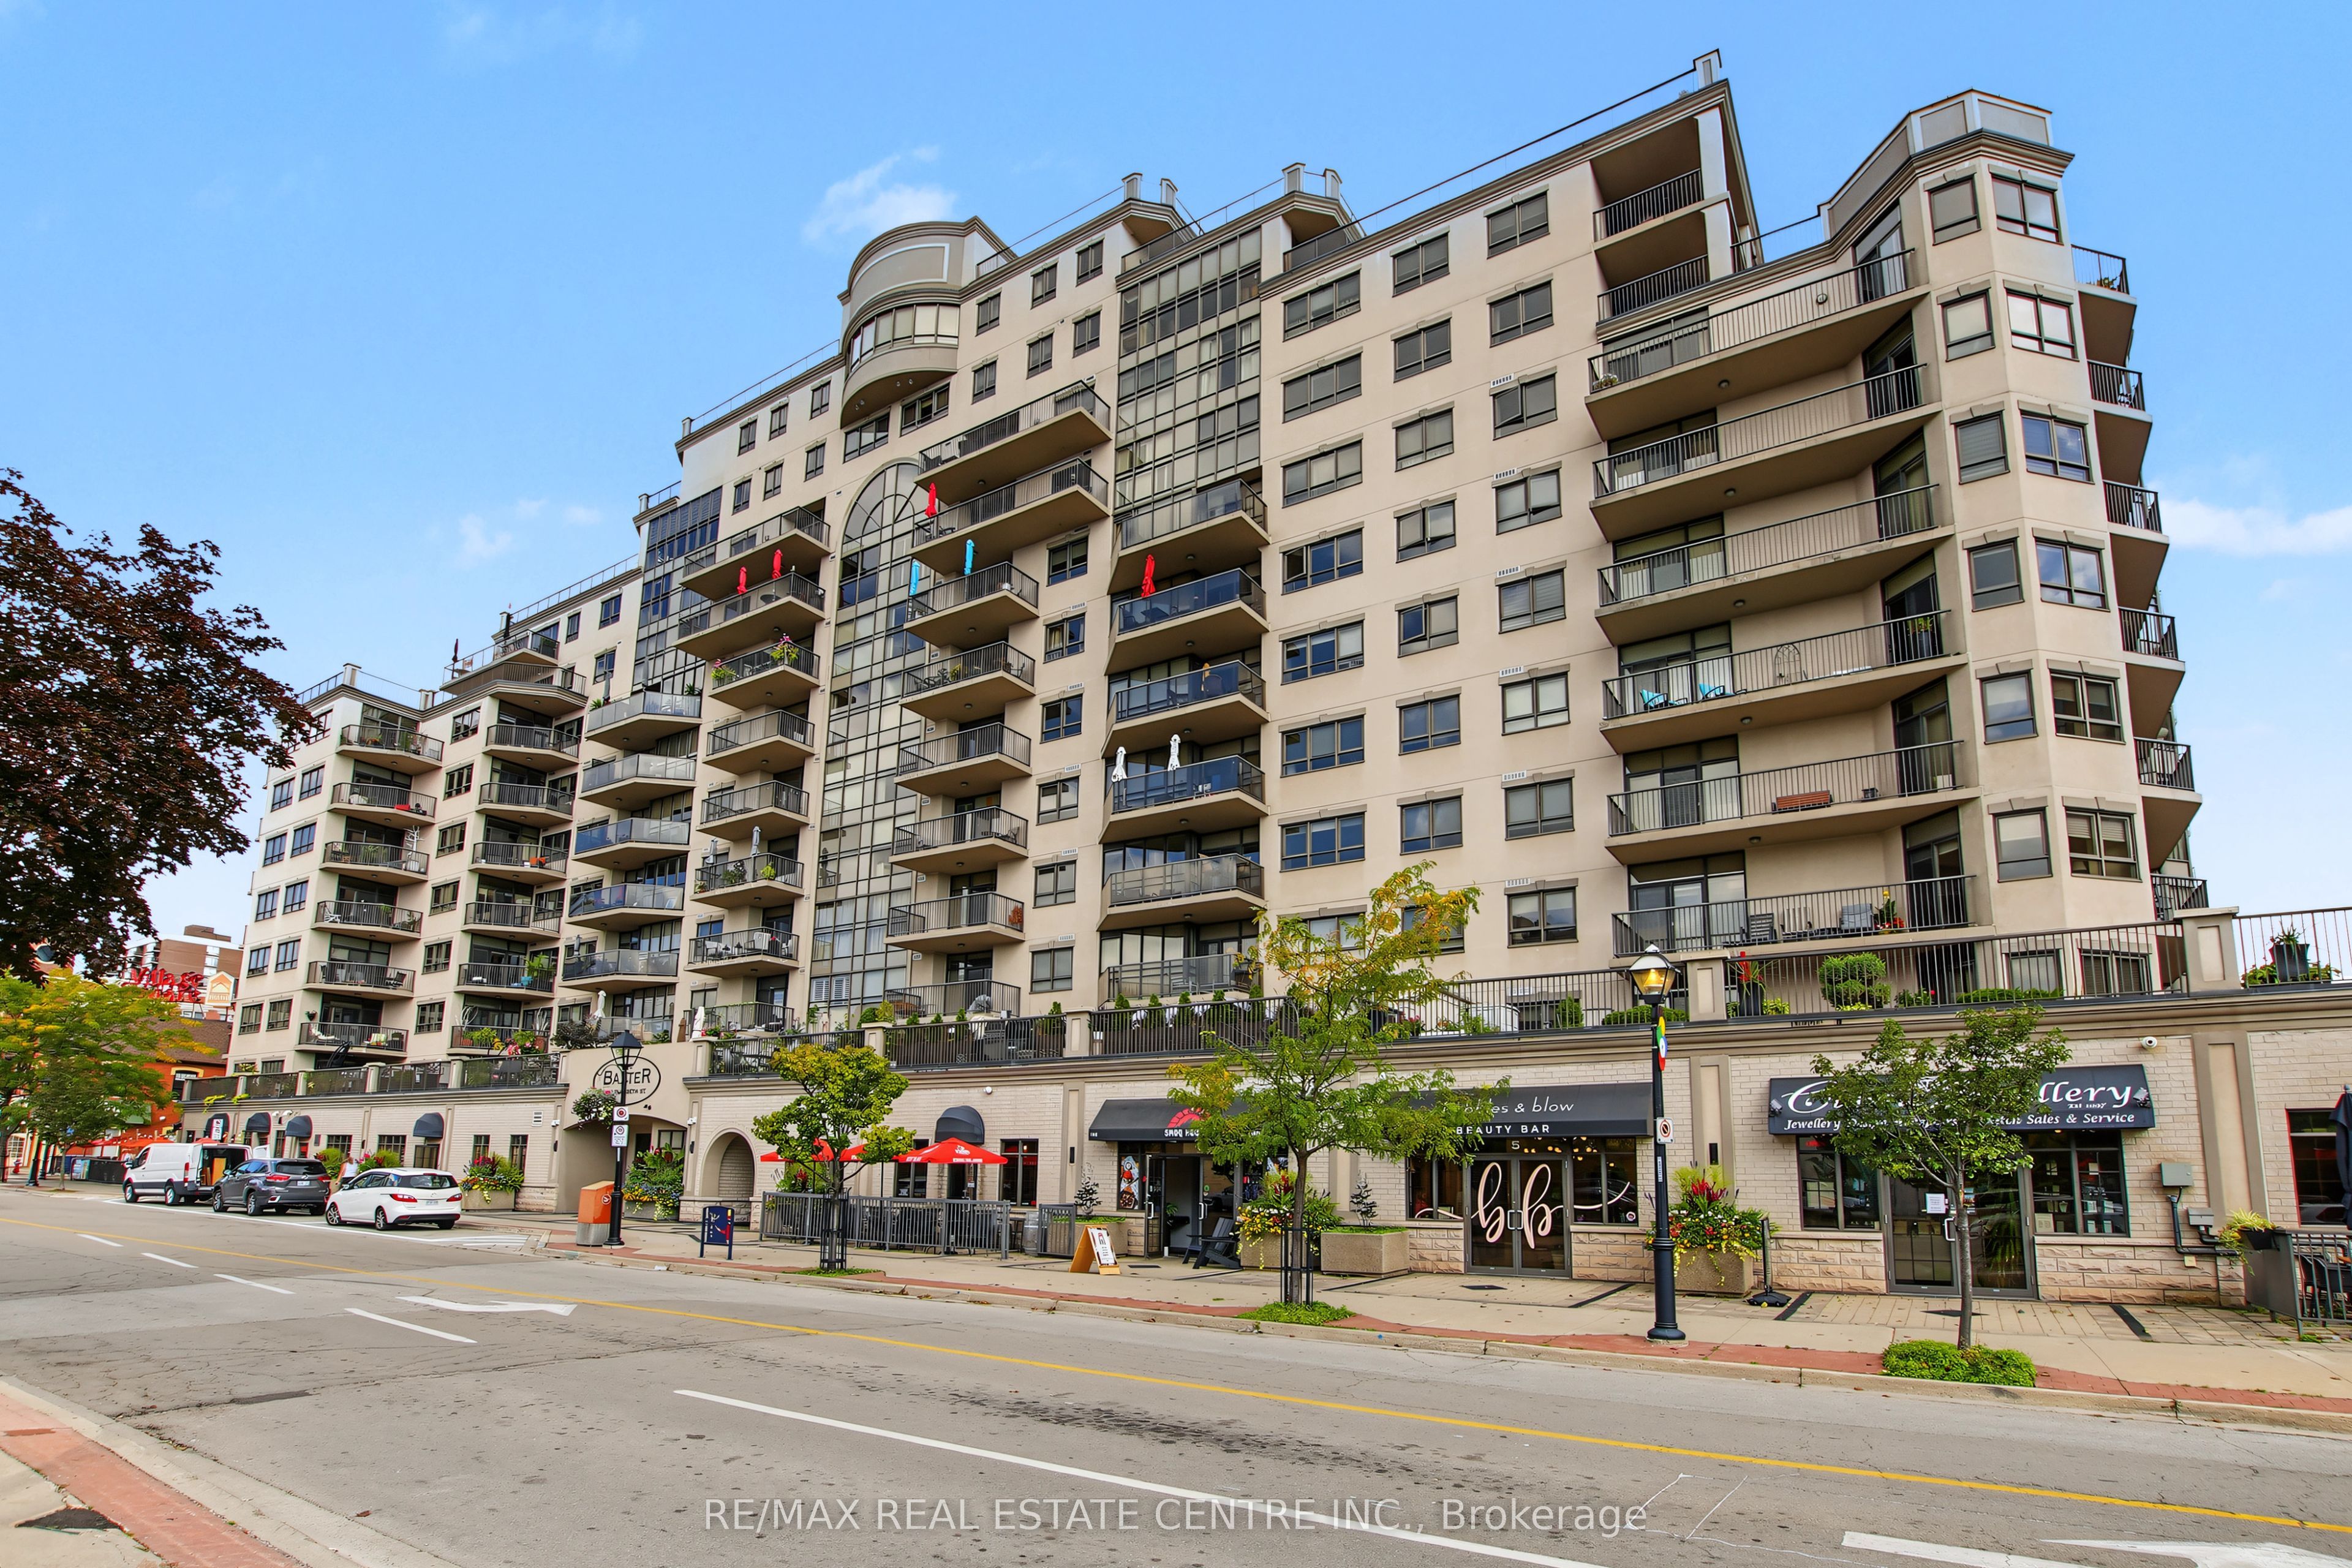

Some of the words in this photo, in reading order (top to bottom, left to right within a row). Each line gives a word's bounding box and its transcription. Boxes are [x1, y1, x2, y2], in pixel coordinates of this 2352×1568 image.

[603, 1068, 651, 1085] BATER
[1514, 1102, 1525, 1114] &
[1532, 1096, 1574, 1112] blow
[1784, 1118, 1841, 1131] Jewellery
[2026, 1114, 2061, 1125] Sales
[2066, 1114, 2078, 1124] &
[2083, 1112, 2135, 1124] Service
[1456, 1125, 1512, 1135] BEAUTY
[1521, 1125, 1550, 1134] BAR
[1511, 1140, 1520, 1150] 5
